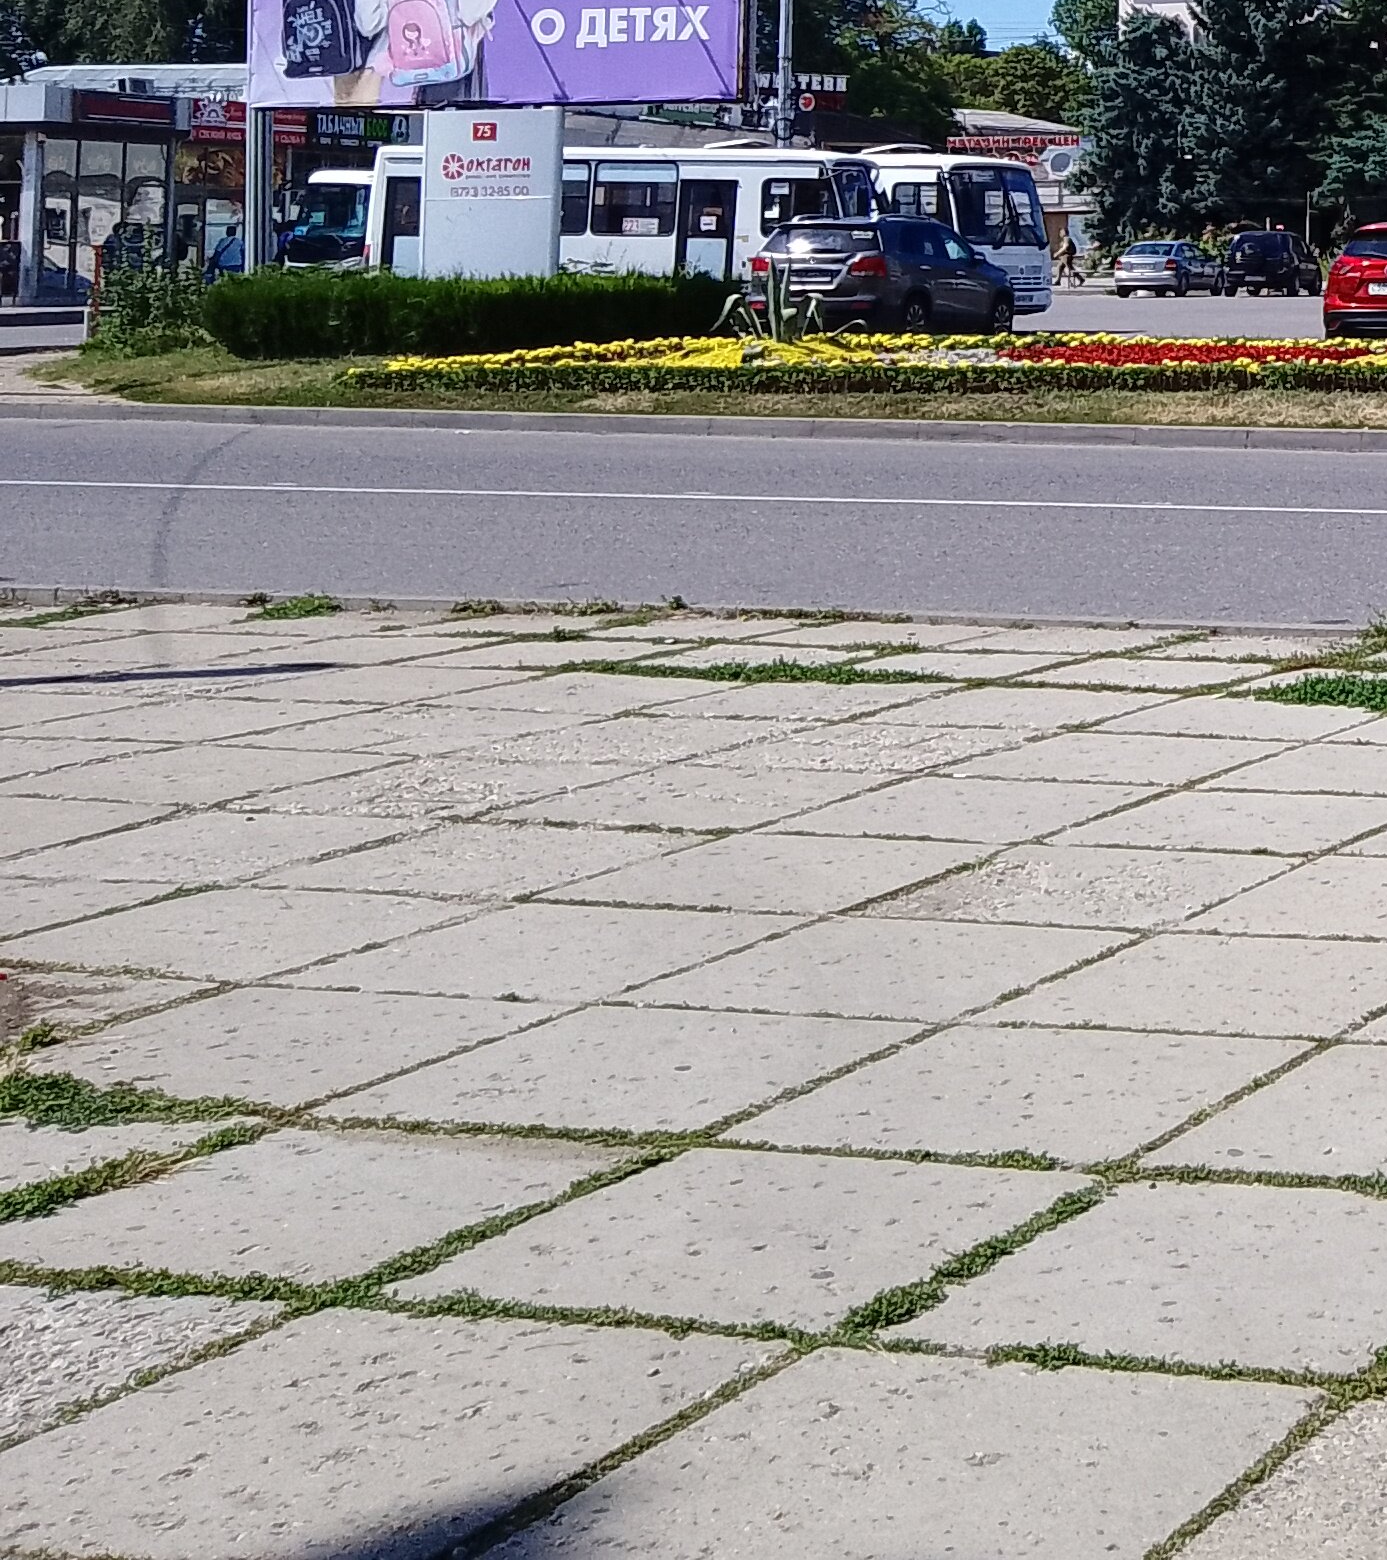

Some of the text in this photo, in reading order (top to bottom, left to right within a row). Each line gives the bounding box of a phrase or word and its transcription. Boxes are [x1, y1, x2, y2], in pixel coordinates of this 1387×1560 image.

[531, 5, 710, 49] О ДЕТЯХ
[476, 124, 492, 138] 75
